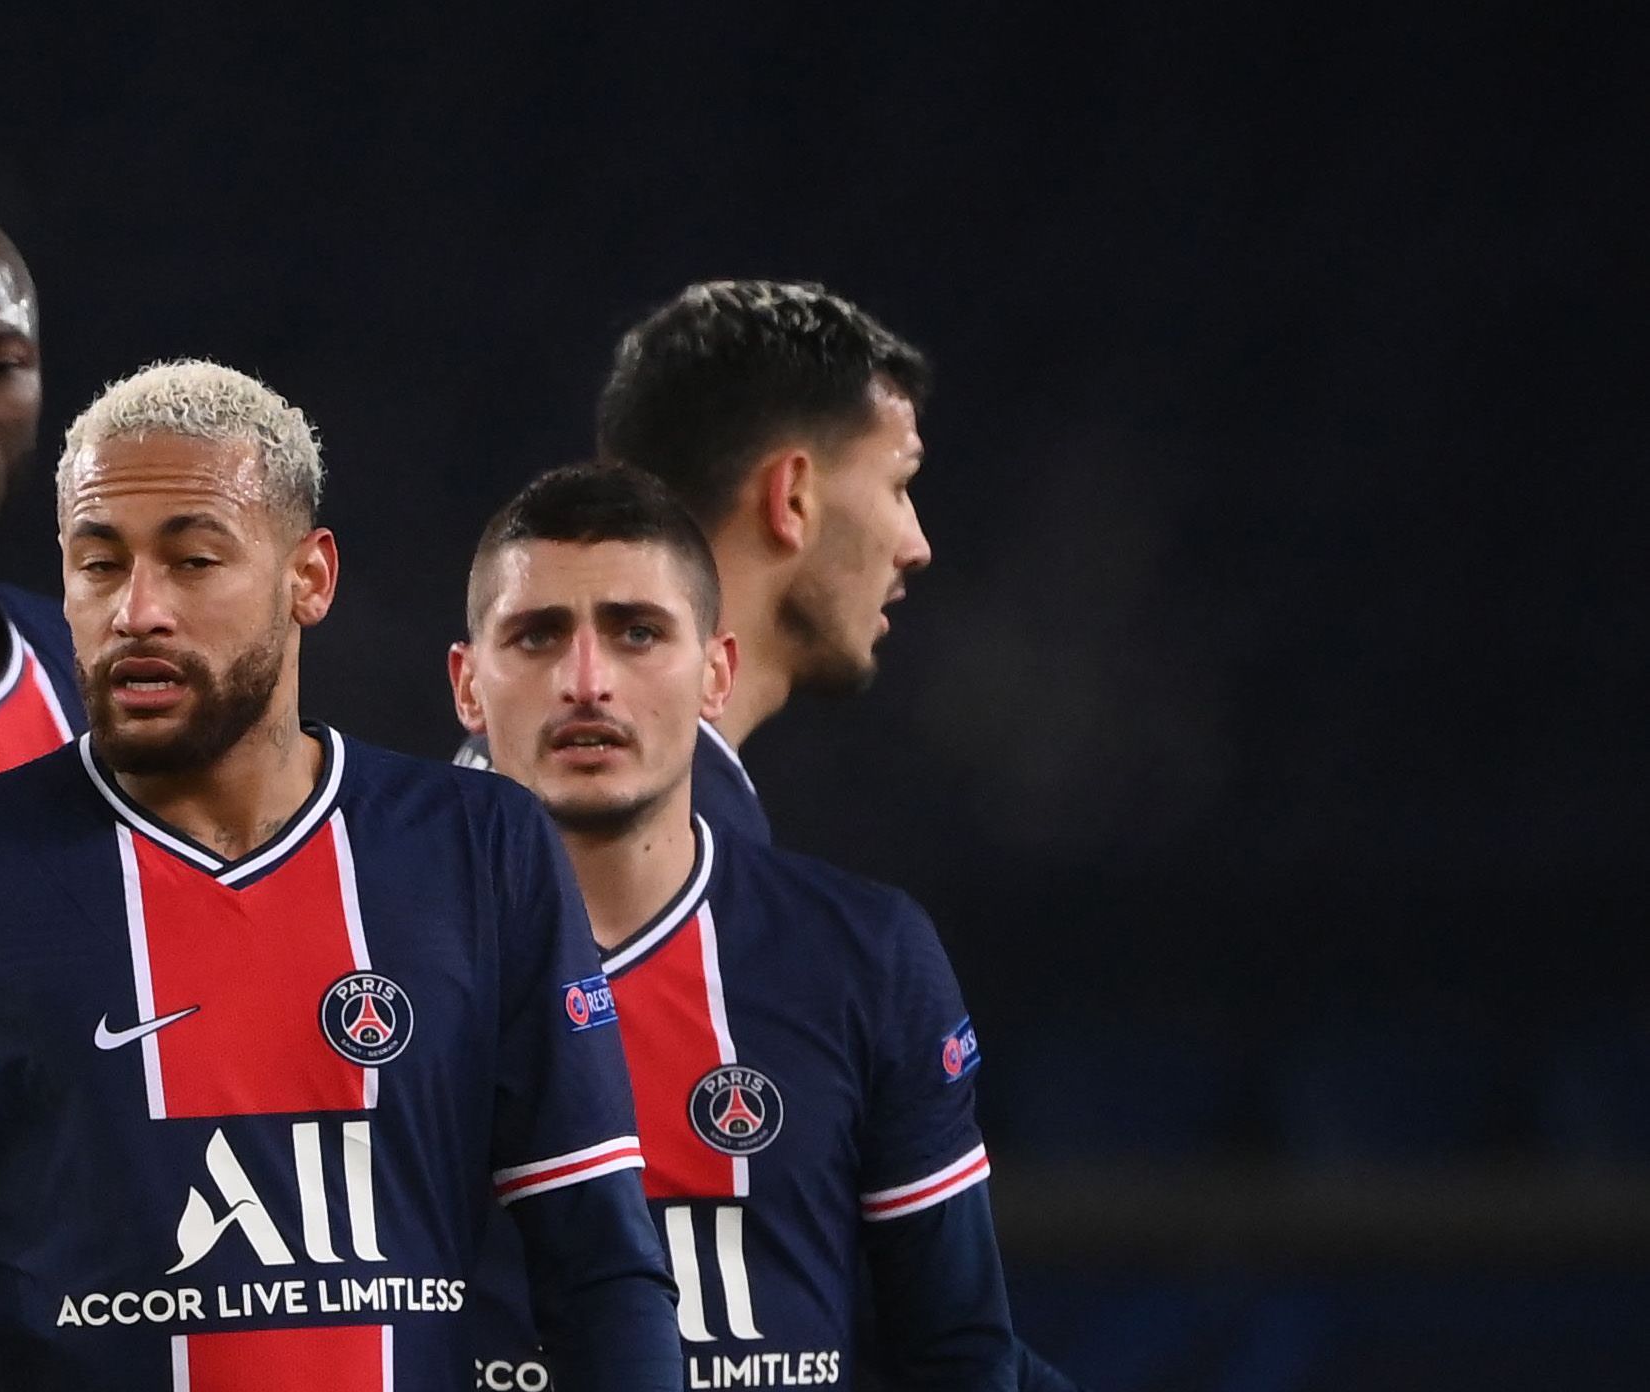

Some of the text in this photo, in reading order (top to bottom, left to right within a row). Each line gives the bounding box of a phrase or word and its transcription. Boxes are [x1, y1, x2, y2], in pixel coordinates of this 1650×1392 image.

[335, 978, 397, 1001] PARIS
[704, 1071, 765, 1094] PARIS
[57, 1278, 466, 1327] ACCOR LIVE LIMITLESS
[689, 1350, 840, 1390] LIMITLESS
